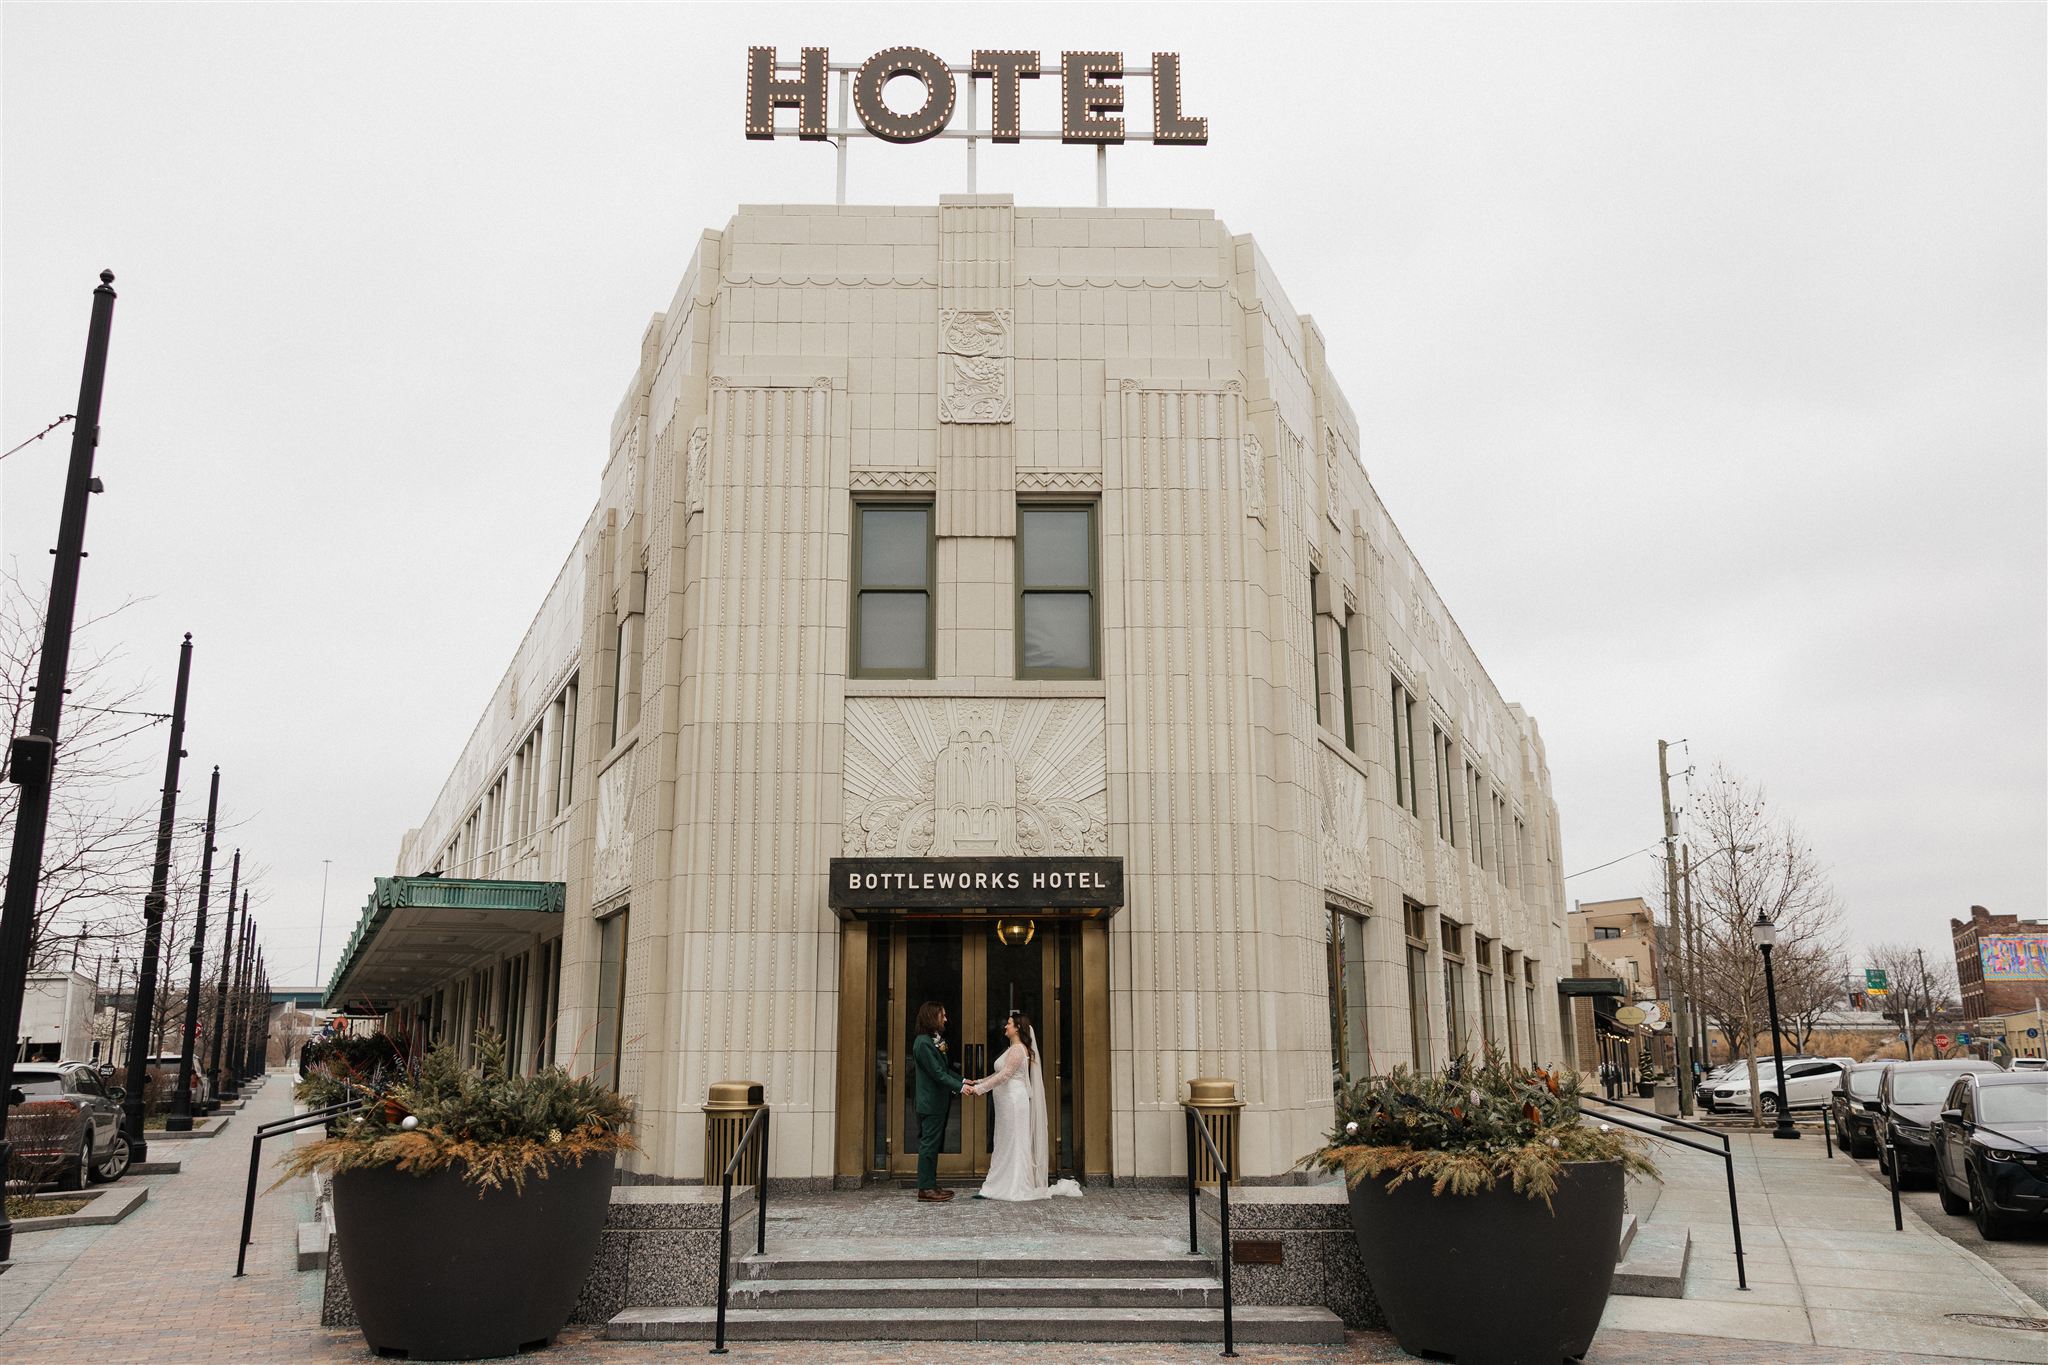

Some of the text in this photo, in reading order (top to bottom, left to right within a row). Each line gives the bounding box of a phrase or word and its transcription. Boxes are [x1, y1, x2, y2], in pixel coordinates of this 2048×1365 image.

[746, 46, 1208, 146] HOTEL
[849, 872, 1106, 890] BOTTLEWORKS HOTEL
